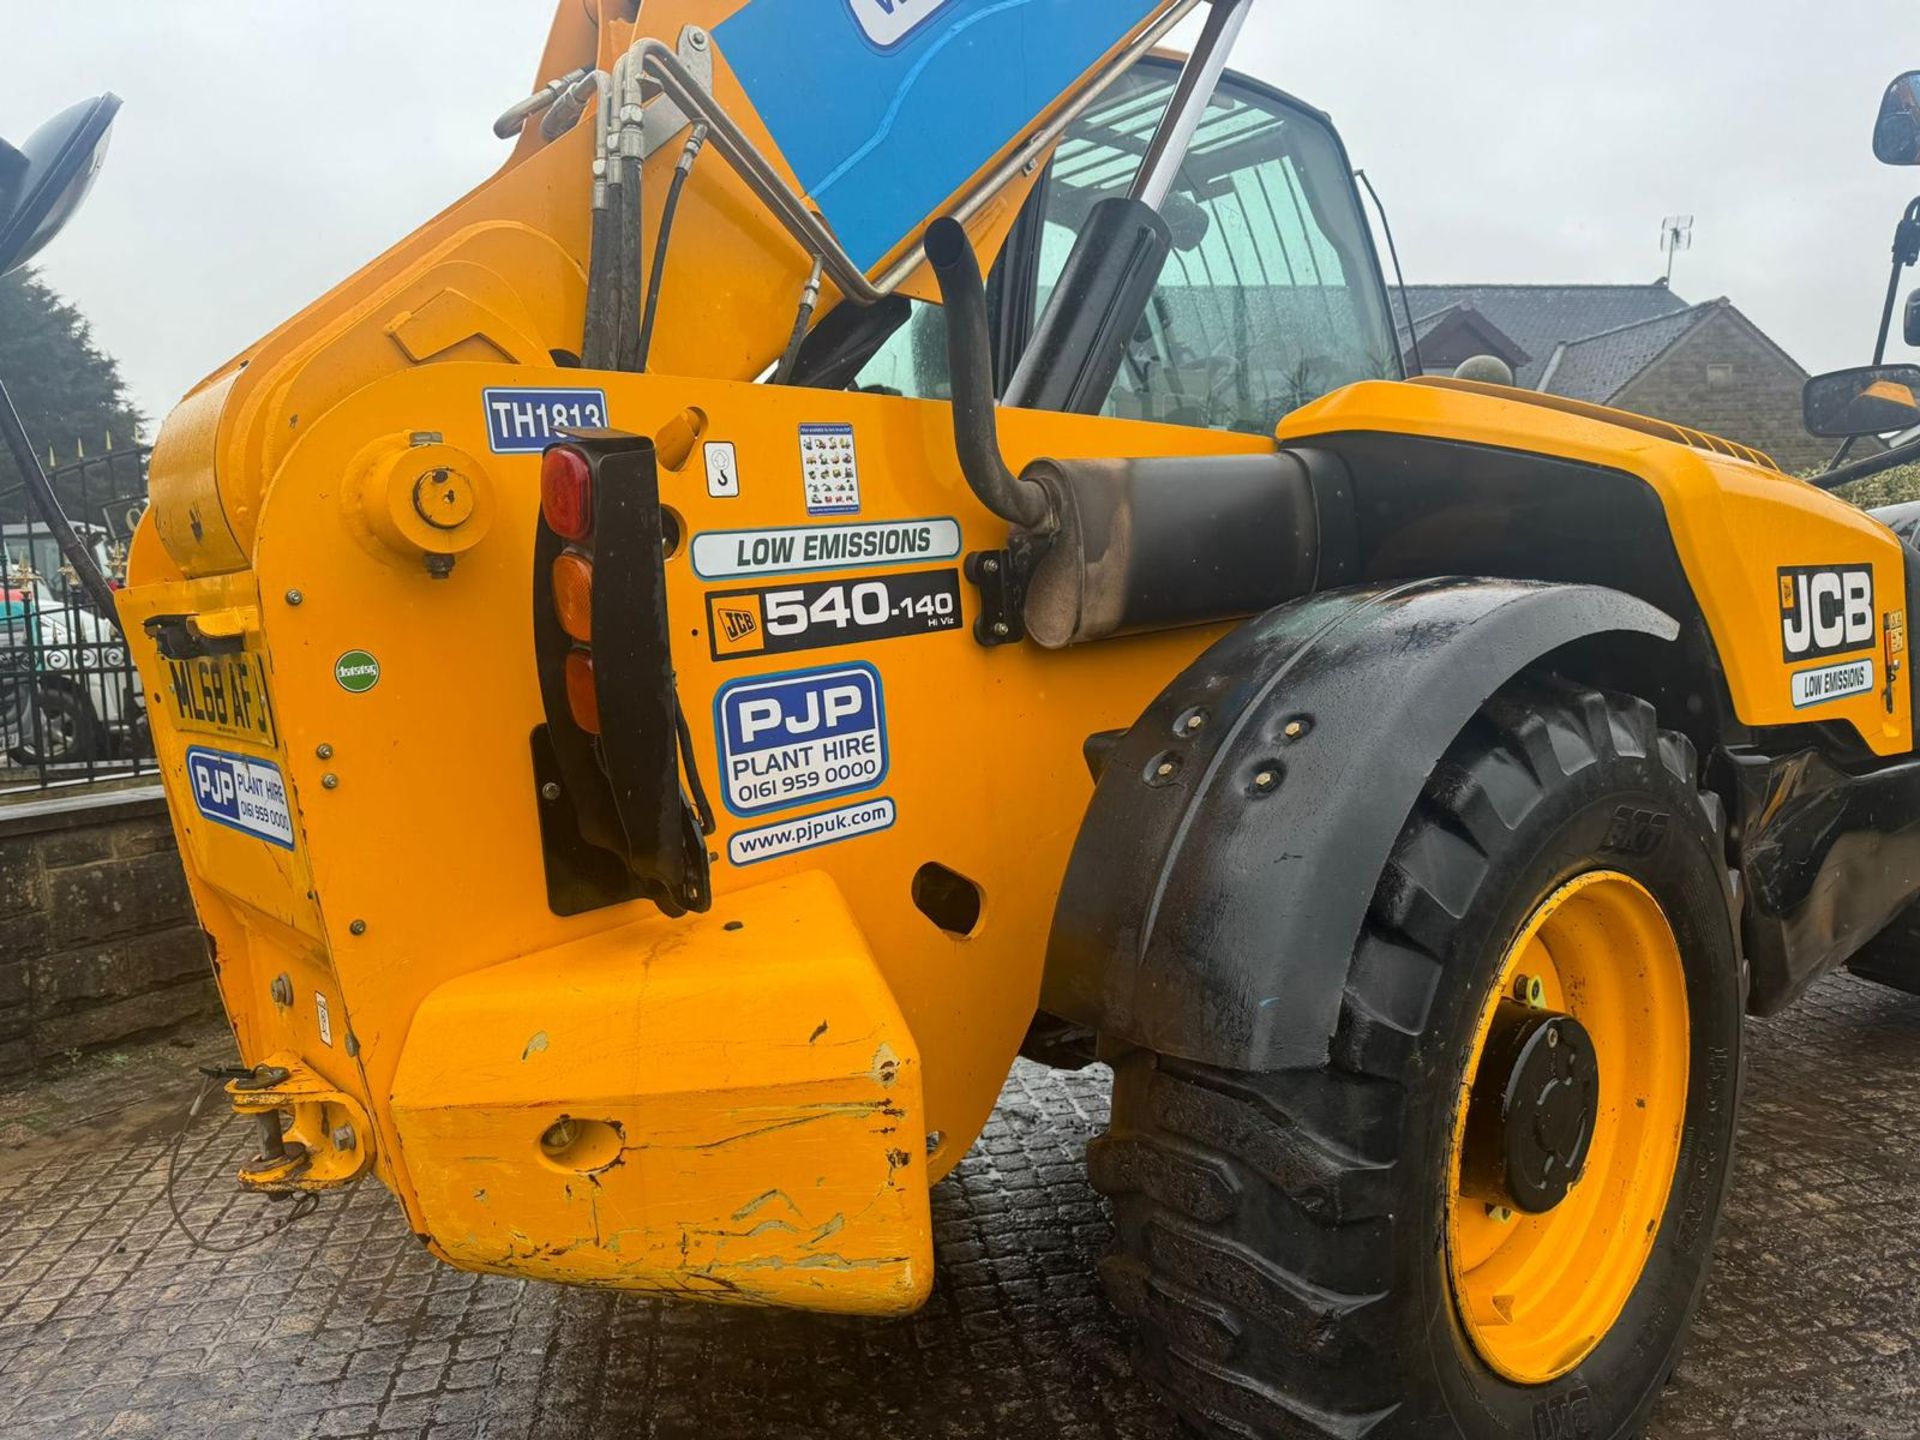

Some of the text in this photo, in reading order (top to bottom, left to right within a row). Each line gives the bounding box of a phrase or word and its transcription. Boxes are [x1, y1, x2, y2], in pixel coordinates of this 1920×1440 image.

[492, 401, 601, 438] TH1813
[736, 527, 931, 567] LOW EMISSIONS
[724, 613, 755, 639] JCB
[765, 582, 954, 637] 540-140
[927, 616, 955, 628] Hi Viz
[1783, 571, 1873, 654] JCB
[169, 660, 228, 725] ML68
[1804, 665, 1865, 698] LOW EMISSIONS
[739, 685, 863, 744] PJP
[732, 734, 876, 781] PLANT HIRE
[195, 764, 235, 806] PJP
[236, 773, 285, 806] PLANT HIRE
[738, 759, 876, 802] 0161 959 0000
[240, 800, 254, 818] 0161
[255, 804, 269, 822] 959
[739, 806, 886, 853] www.pjpuk.com
